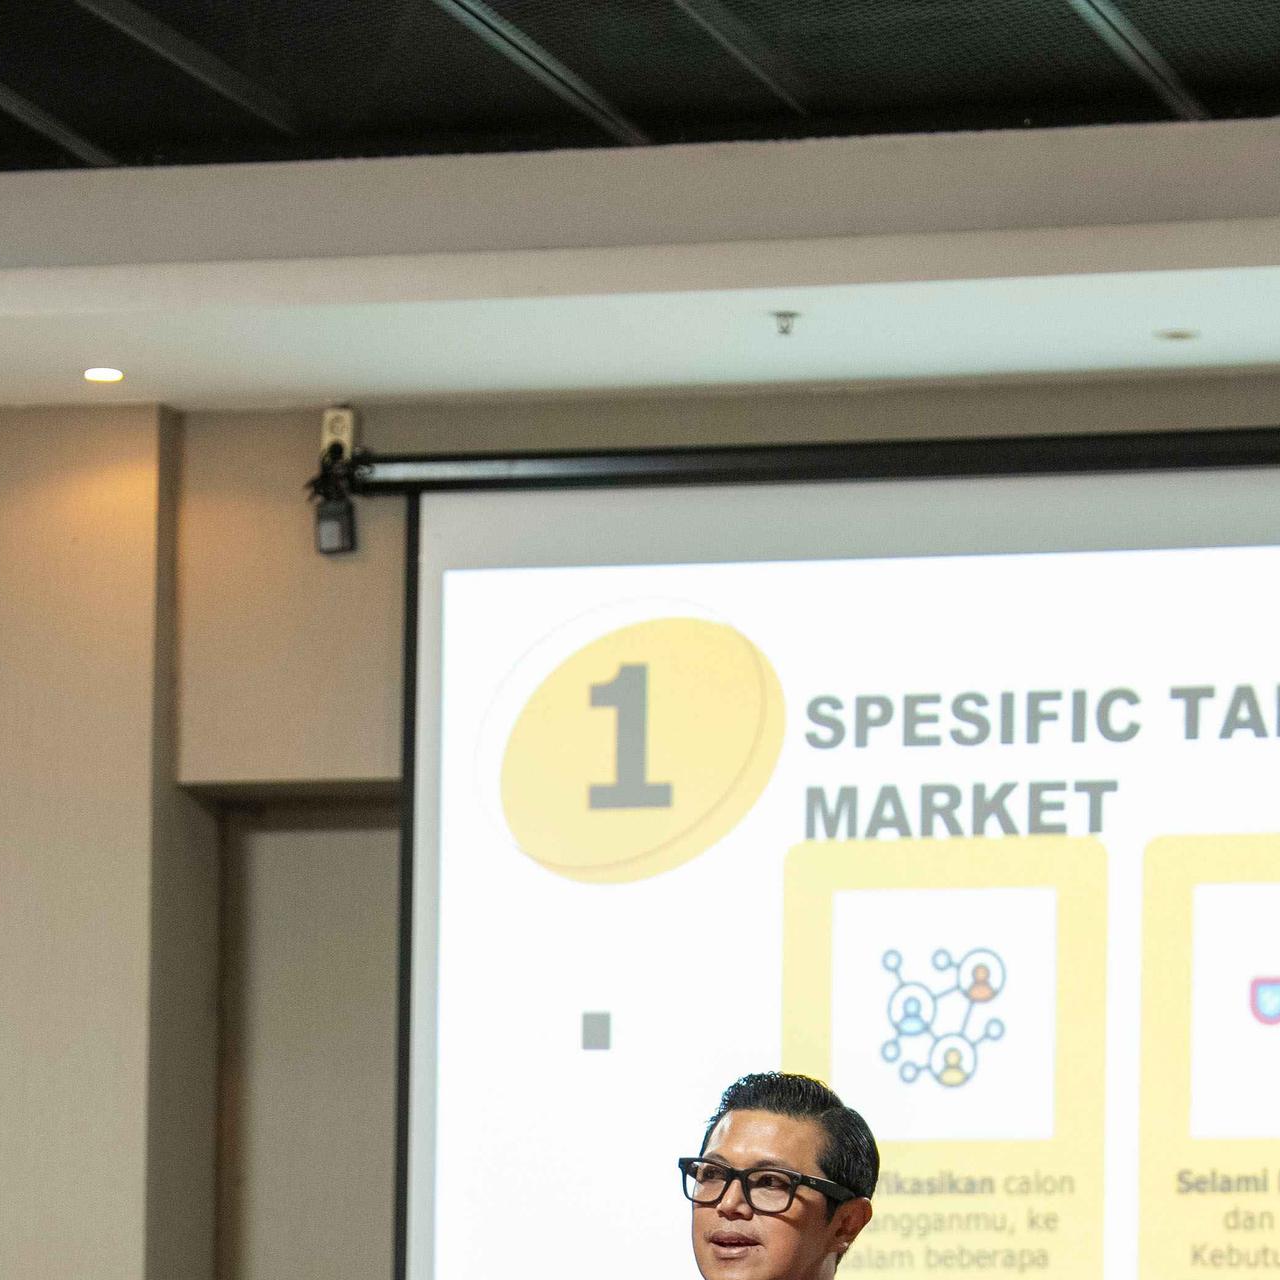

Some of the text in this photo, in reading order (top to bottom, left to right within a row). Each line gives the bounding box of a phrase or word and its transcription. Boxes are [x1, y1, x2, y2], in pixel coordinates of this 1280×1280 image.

[804, 687, 1143, 750] SPESIFIC
[588, 662, 674, 809] 1
[803, 777, 1119, 841] MARKET
[1003, 1168, 1076, 1196] calon
[1175, 1168, 1269, 1194] Selami
[1026, 1207, 1059, 1231] ke
[1222, 1204, 1275, 1231] dan
[925, 1244, 1049, 1273] beberapa
